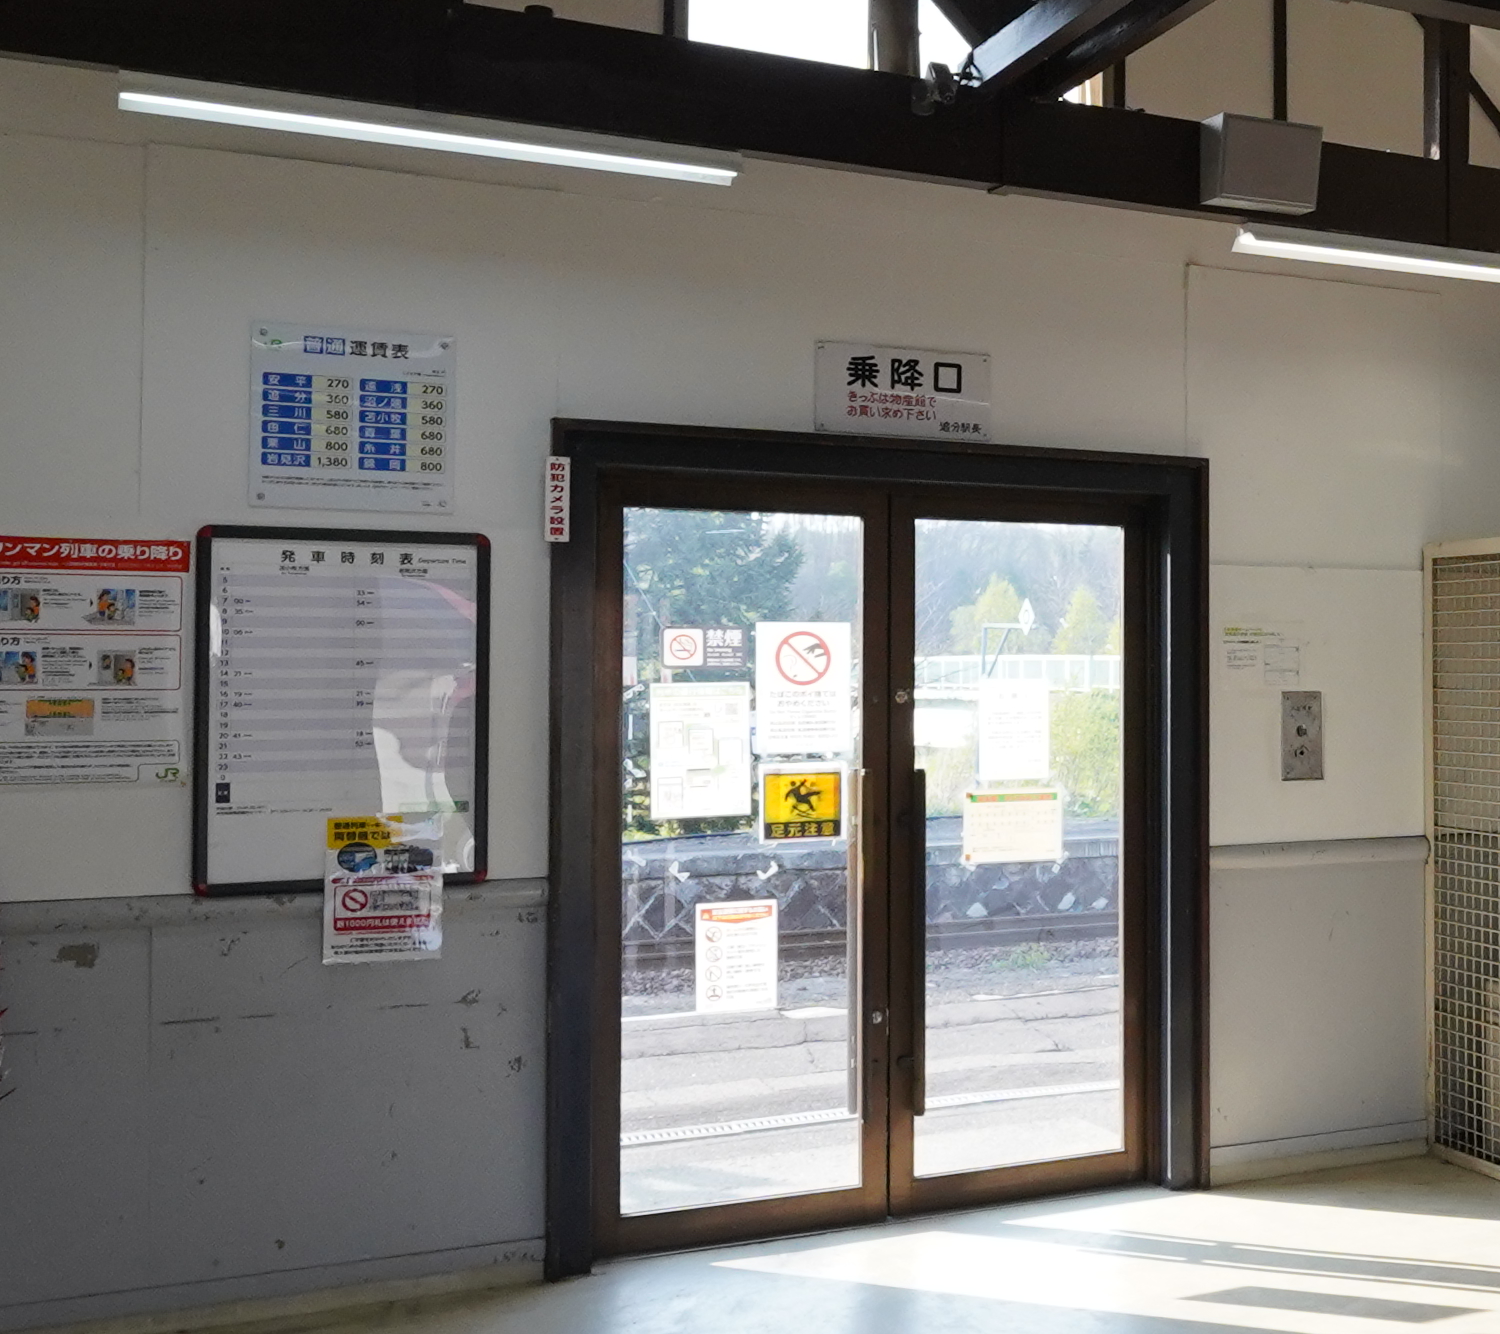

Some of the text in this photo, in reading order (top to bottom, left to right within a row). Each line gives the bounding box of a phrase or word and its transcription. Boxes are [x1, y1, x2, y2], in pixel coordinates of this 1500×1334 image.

[846, 355, 962, 394] 乗降口
[327, 378, 349, 389] 270
[421, 385, 444, 395] 270
[326, 394, 349, 405] 360
[421, 400, 443, 410] 360
[847, 390, 937, 409] きっぷは物産館で
[268, 406, 349, 420] 三川 580
[846, 405, 938, 422] お買い求め下さい
[421, 416, 443, 426] 580
[325, 426, 348, 436] 680
[939, 421, 982, 435] 追分駅長
[420, 431, 443, 441] 680
[325, 441, 348, 452] 800
[420, 446, 442, 457] 680
[317, 457, 348, 468] 1,380
[420, 462, 442, 472] 800
[549, 461, 566, 537] 防犯カメラ設置
[281, 549, 414, 566] 発車時刻表
[705, 629, 743, 647] 禁煙
[769, 690, 837, 699] たばこのポイ捨ては
[777, 699, 831, 708] おやめください
[155, 767, 180, 780] JR
[770, 823, 835, 838] 足元注意
